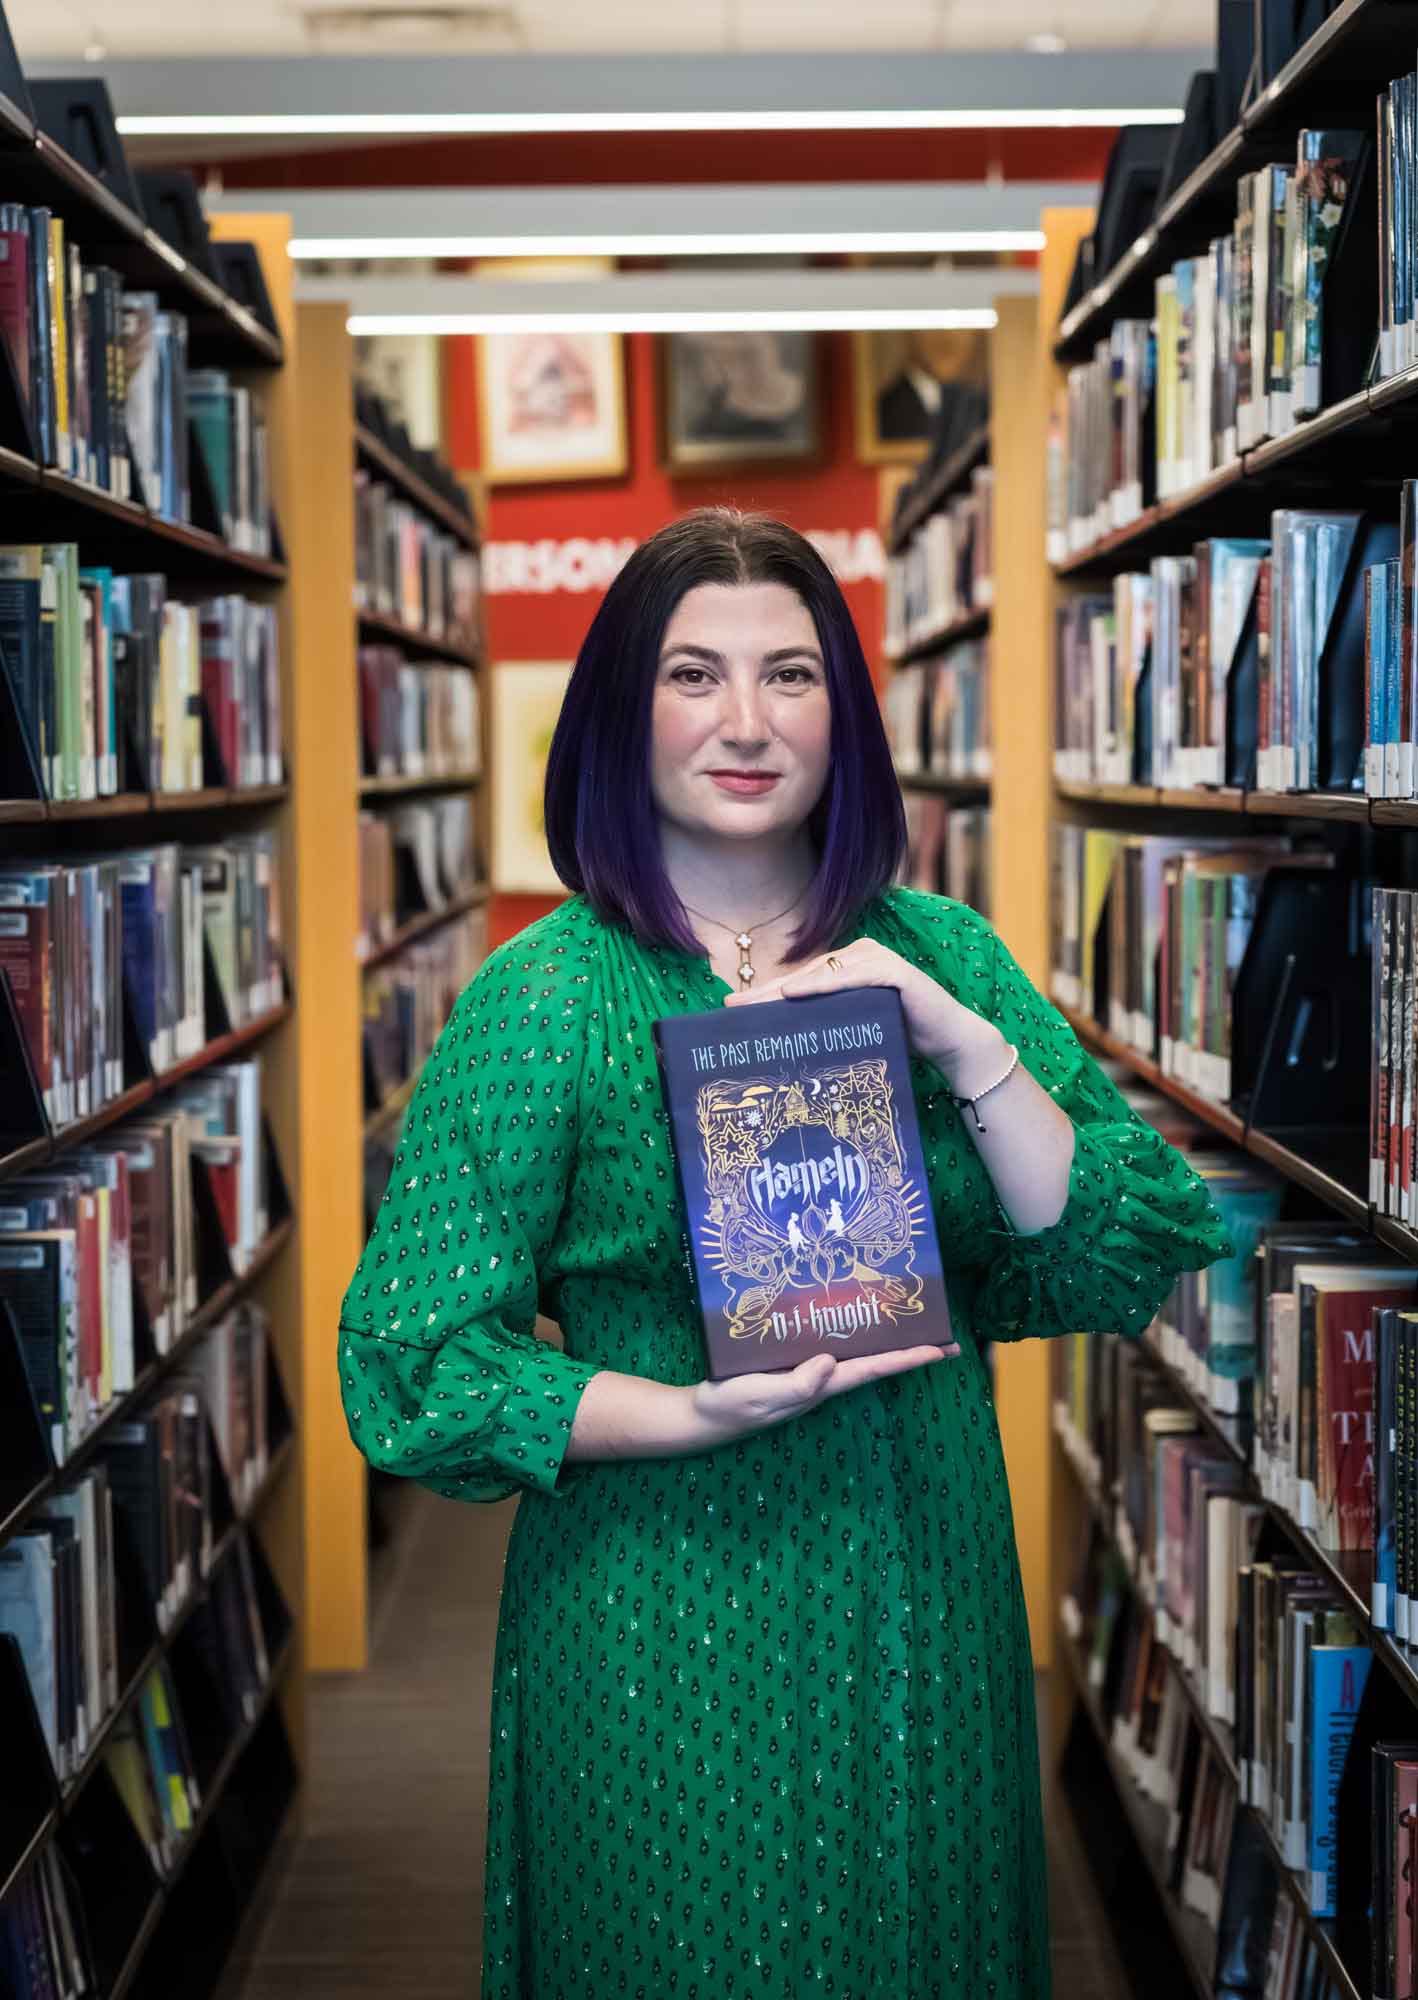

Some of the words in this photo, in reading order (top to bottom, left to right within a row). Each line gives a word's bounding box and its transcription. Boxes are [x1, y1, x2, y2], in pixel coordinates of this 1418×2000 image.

[481, 537, 638, 594] ERSON
[690, 1045, 717, 1072] THE
[721, 1040, 750, 1066] PAST
[754, 1031, 819, 1064] REMAINS
[822, 1023, 883, 1053] UNSUNG
[750, 1144, 867, 1216] Hameln
[1343, 1330, 1375, 1363] M
